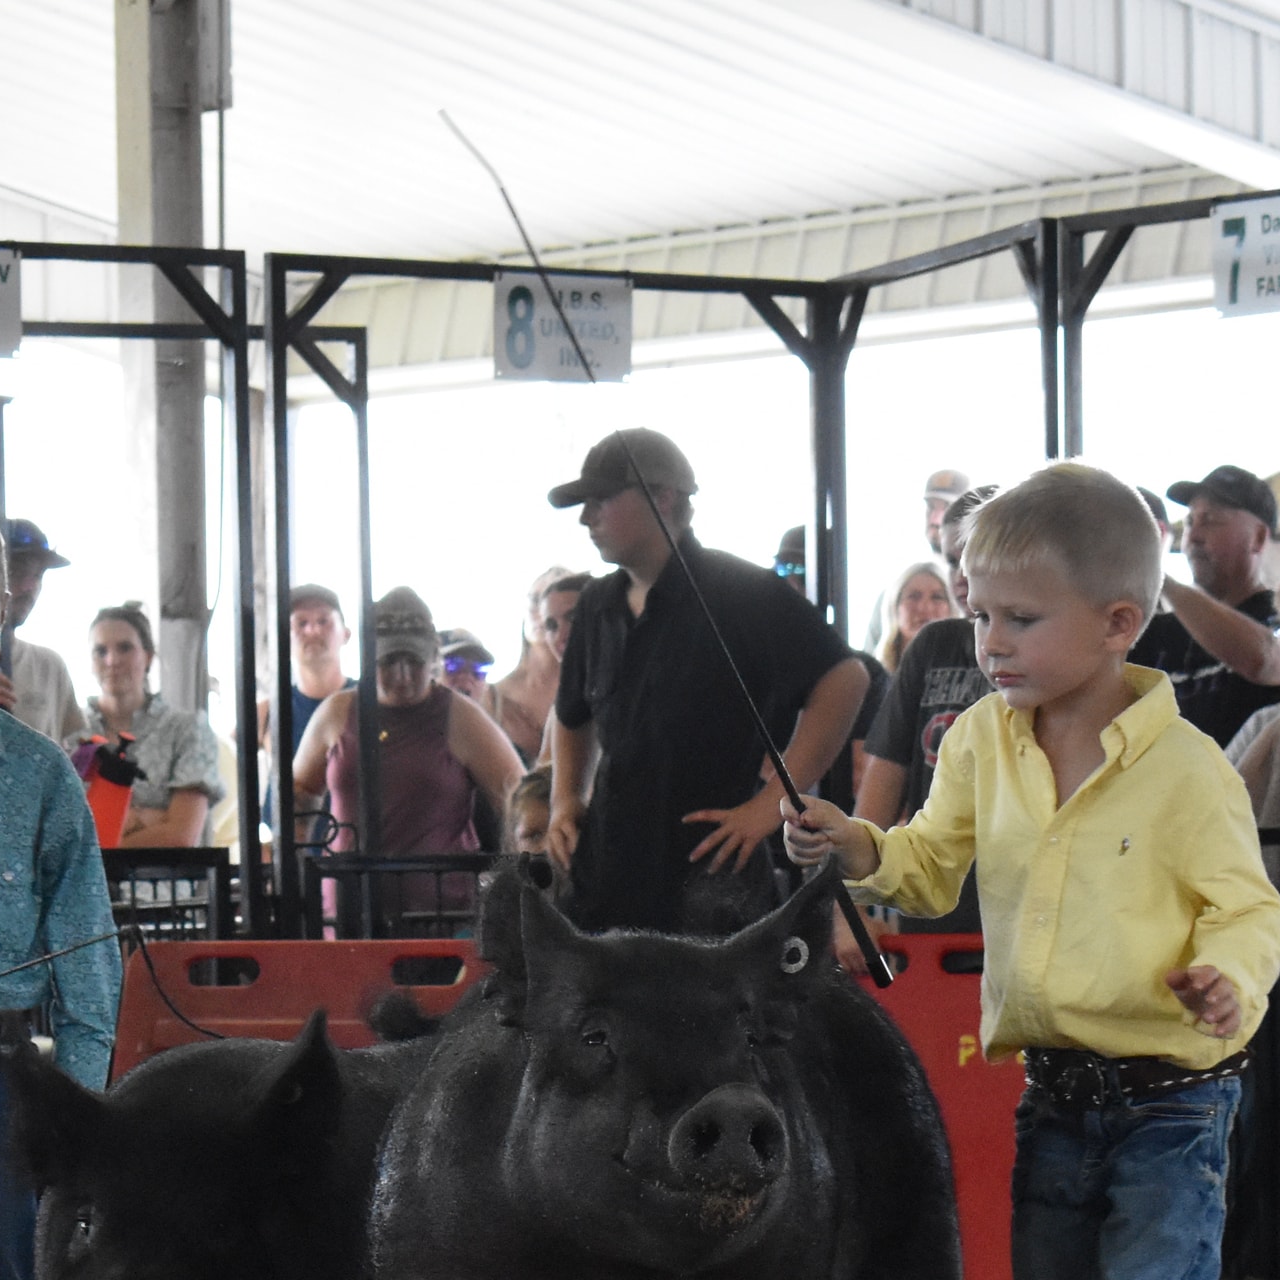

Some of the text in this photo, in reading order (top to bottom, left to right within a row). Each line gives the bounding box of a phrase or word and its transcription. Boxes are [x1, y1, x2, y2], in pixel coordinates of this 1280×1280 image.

[1222, 216, 1246, 305] 7
[505, 285, 536, 370] 8
[540, 318, 620, 345] UNTED,
